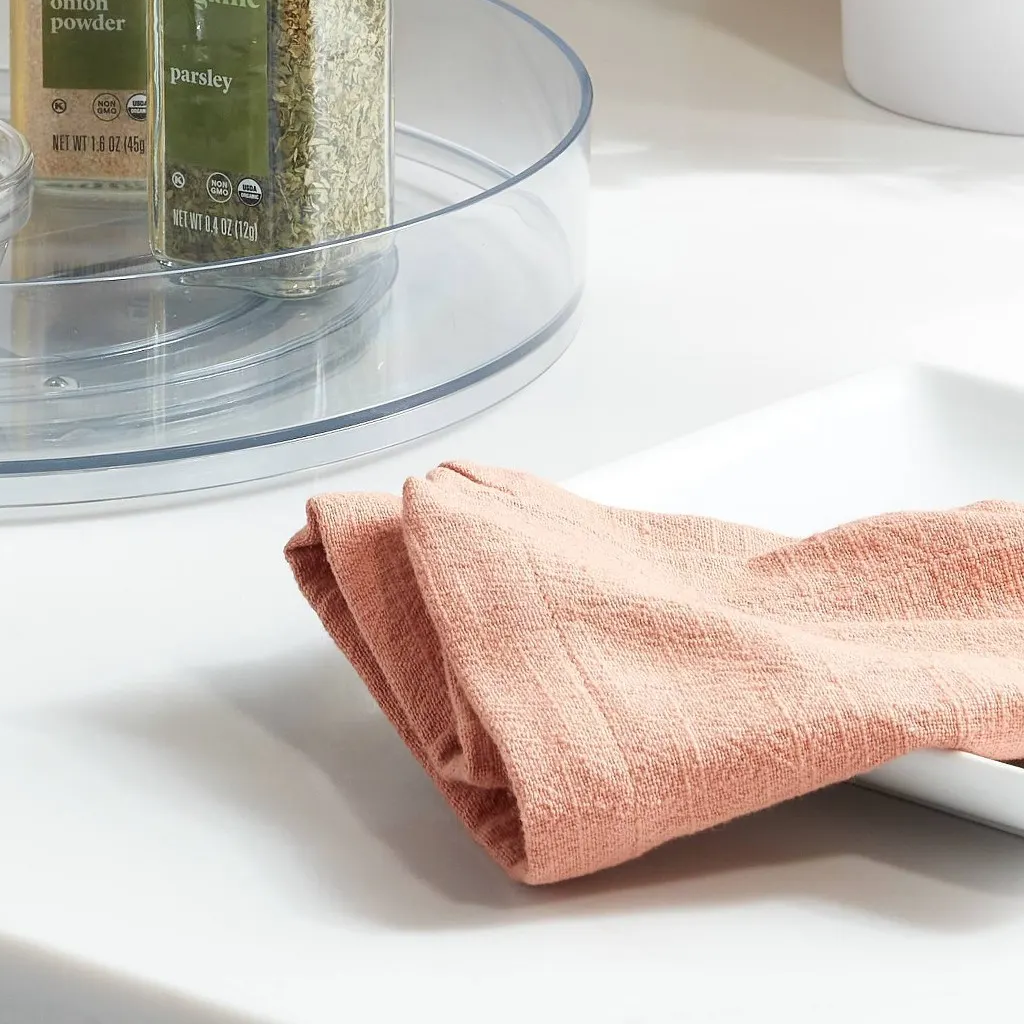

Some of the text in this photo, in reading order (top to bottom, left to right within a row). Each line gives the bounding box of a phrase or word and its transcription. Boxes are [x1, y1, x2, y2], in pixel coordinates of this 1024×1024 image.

[50, 14, 126, 33] powder
[170, 67, 233, 93] parsley
[52, 134, 146, 154] NET WT 1.6 OZ (45g
[210, 187, 229, 196] GMO
[211, 179, 228, 189] NON
[173, 209, 258, 242] NET WT 0.4 OZ (12g)
